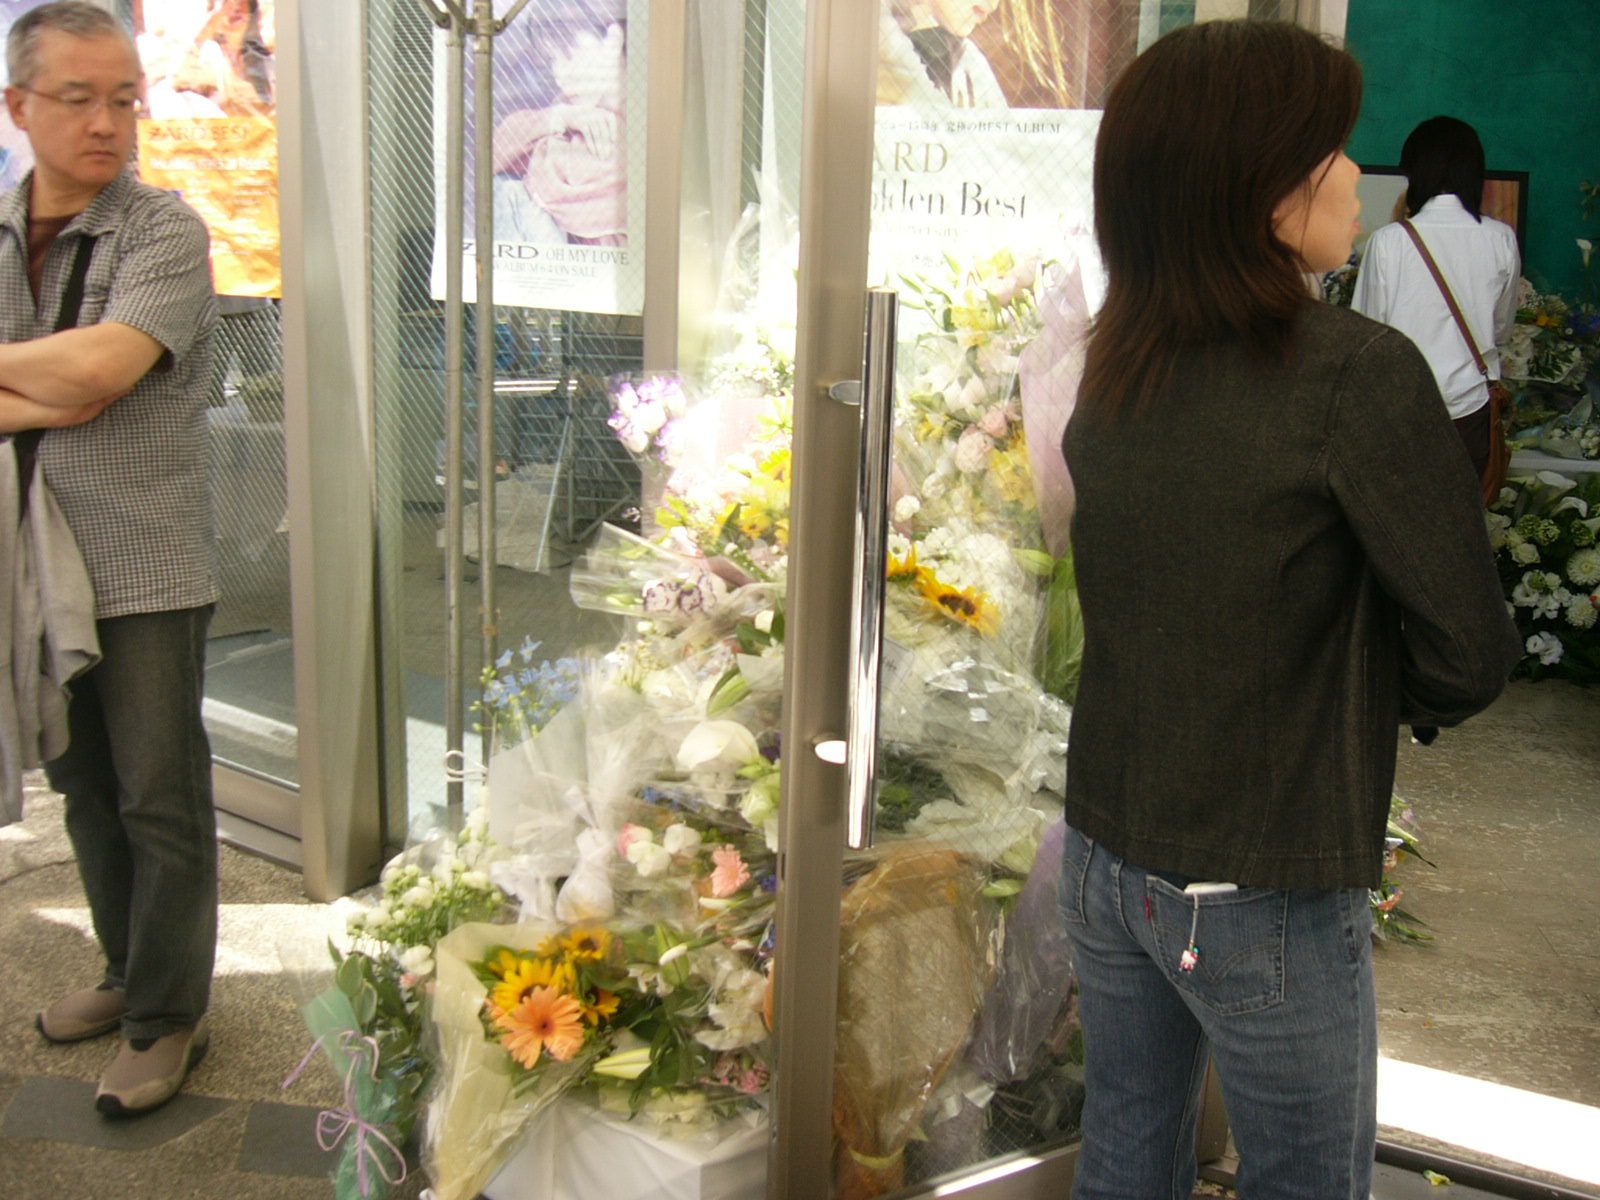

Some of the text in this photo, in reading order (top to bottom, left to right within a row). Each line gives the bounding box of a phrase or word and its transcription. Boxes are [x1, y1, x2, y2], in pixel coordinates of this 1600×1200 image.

[1016, 123, 1061, 134] ALBUM
[960, 181, 1026, 219] Best
[462, 242, 630, 266] ZRD OH MY LOVE
[504, 262, 538, 273] ALBUM
[571, 266, 597, 278] SALE
